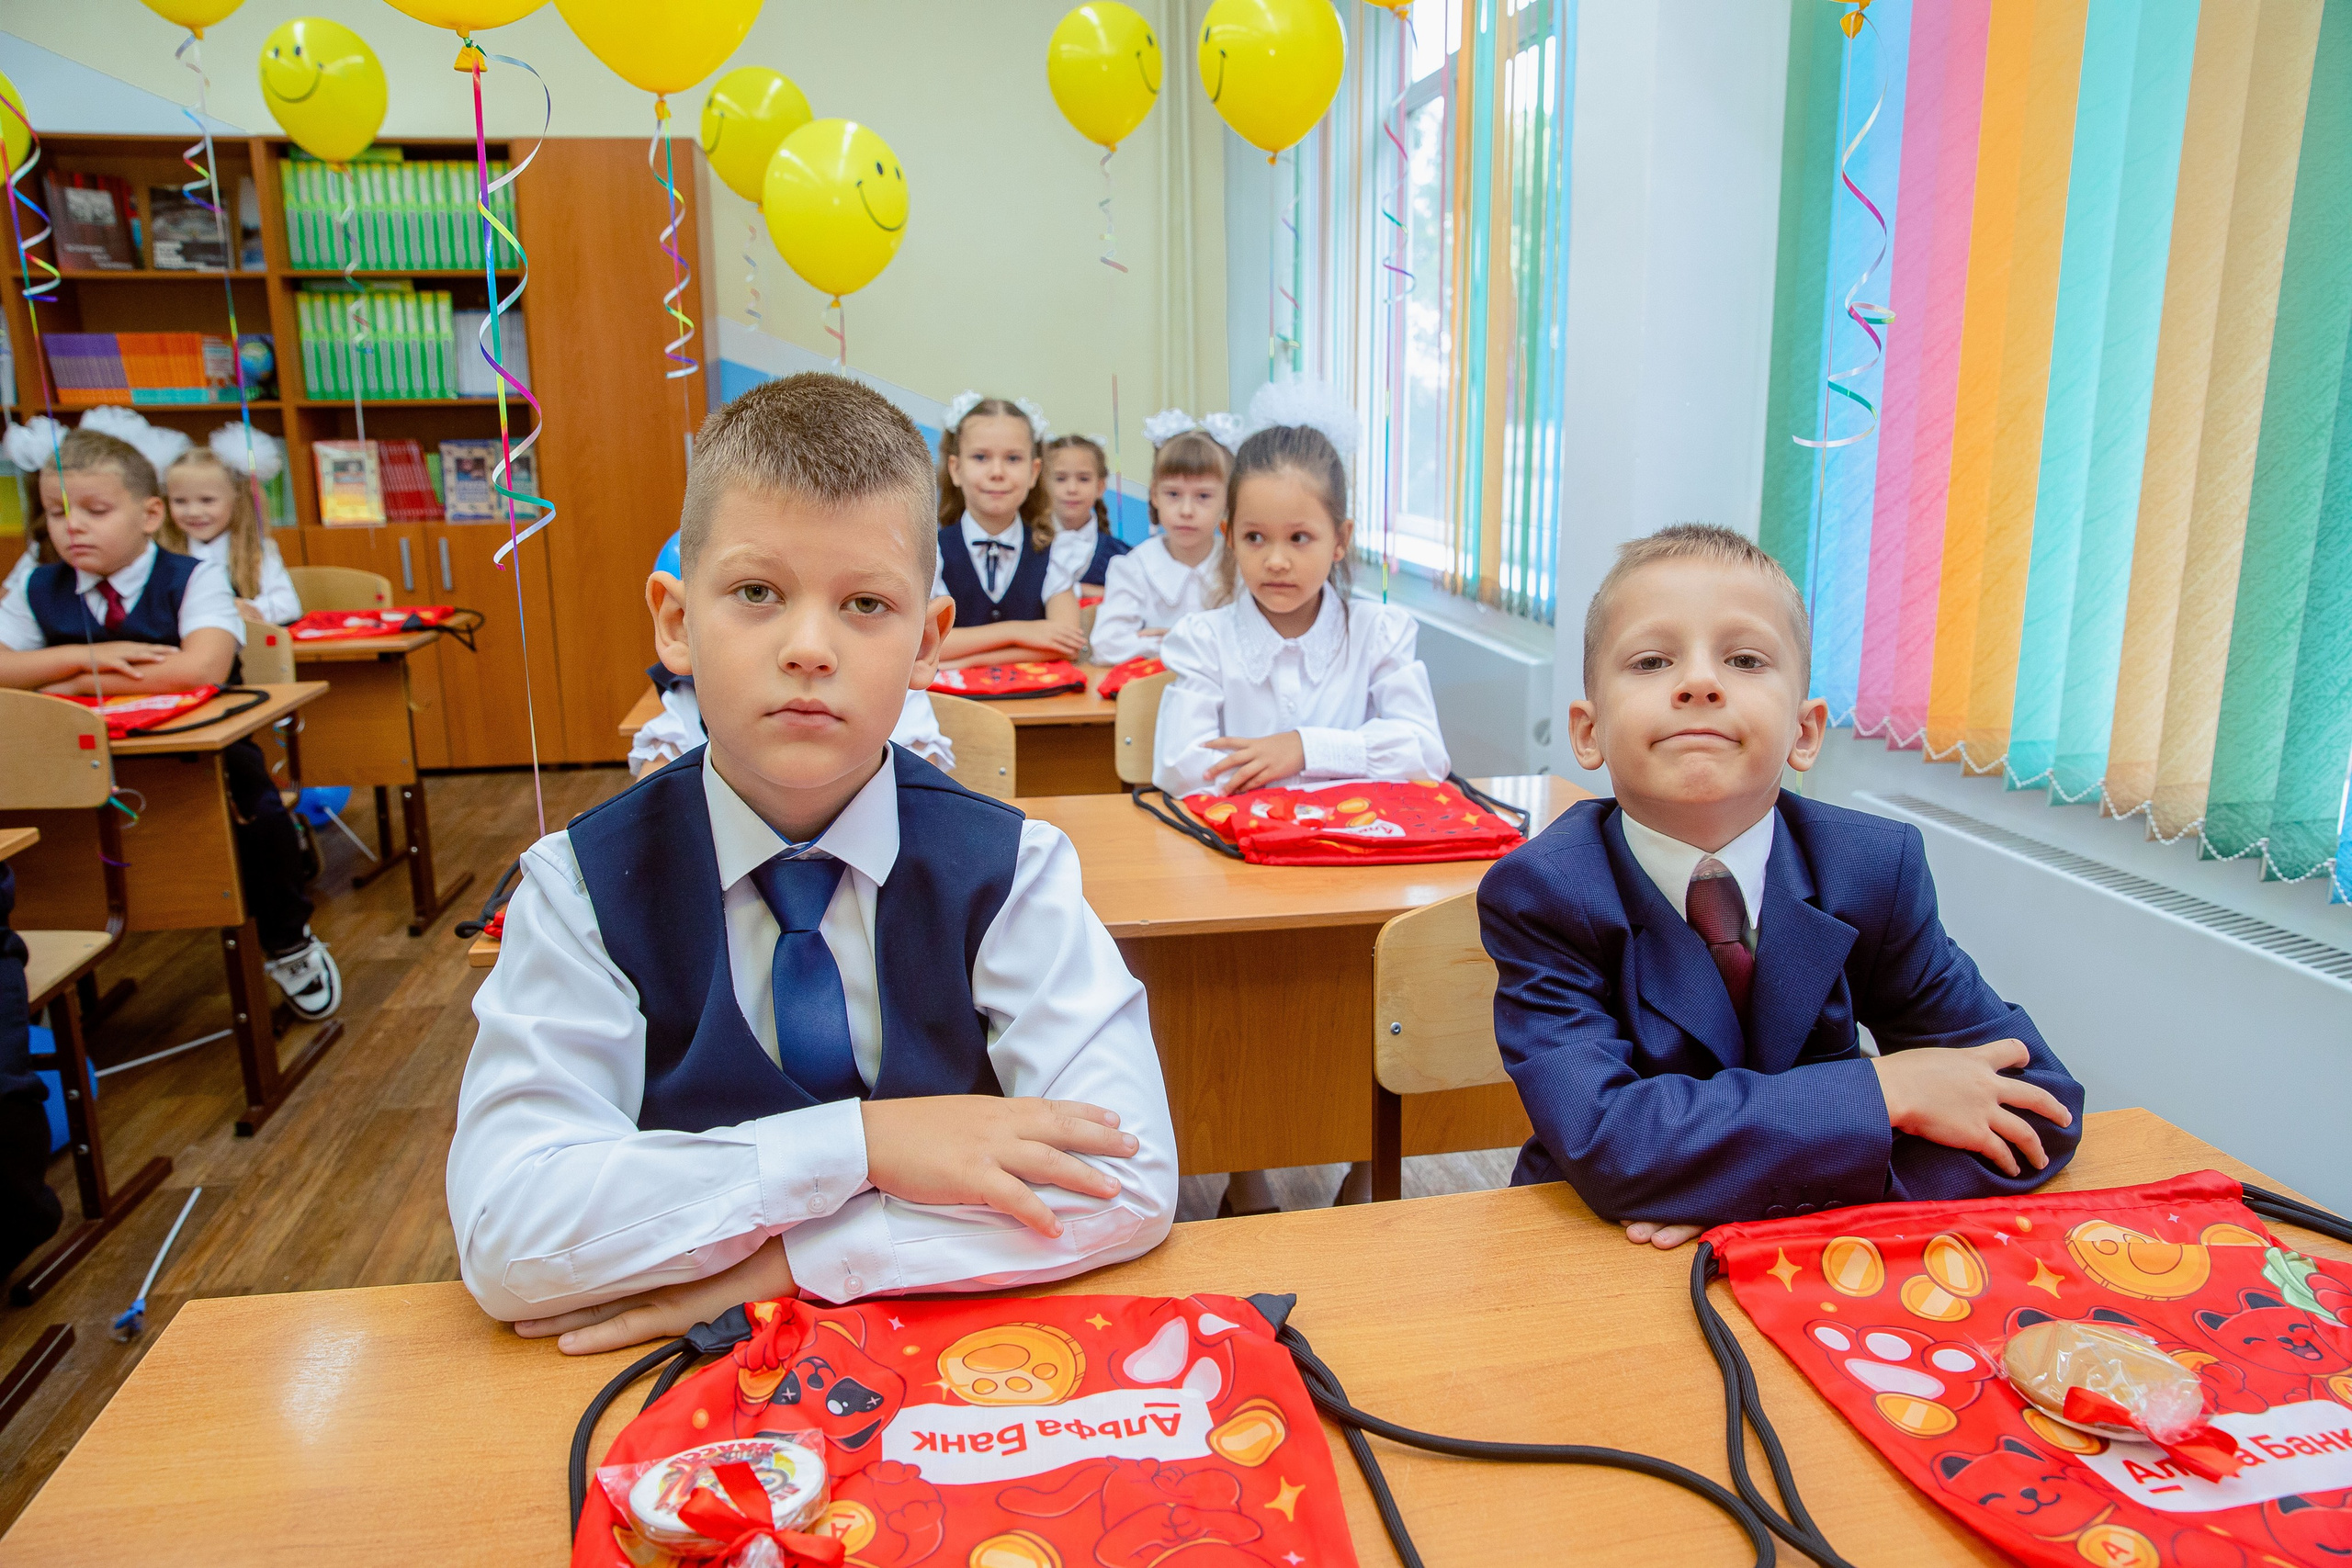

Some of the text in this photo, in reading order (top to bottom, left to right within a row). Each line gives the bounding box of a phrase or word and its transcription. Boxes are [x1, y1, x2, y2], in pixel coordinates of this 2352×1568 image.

[910, 1411, 1182, 1457] Альфа Банк
[2121, 1427, 2352, 1484] Ала Банк
